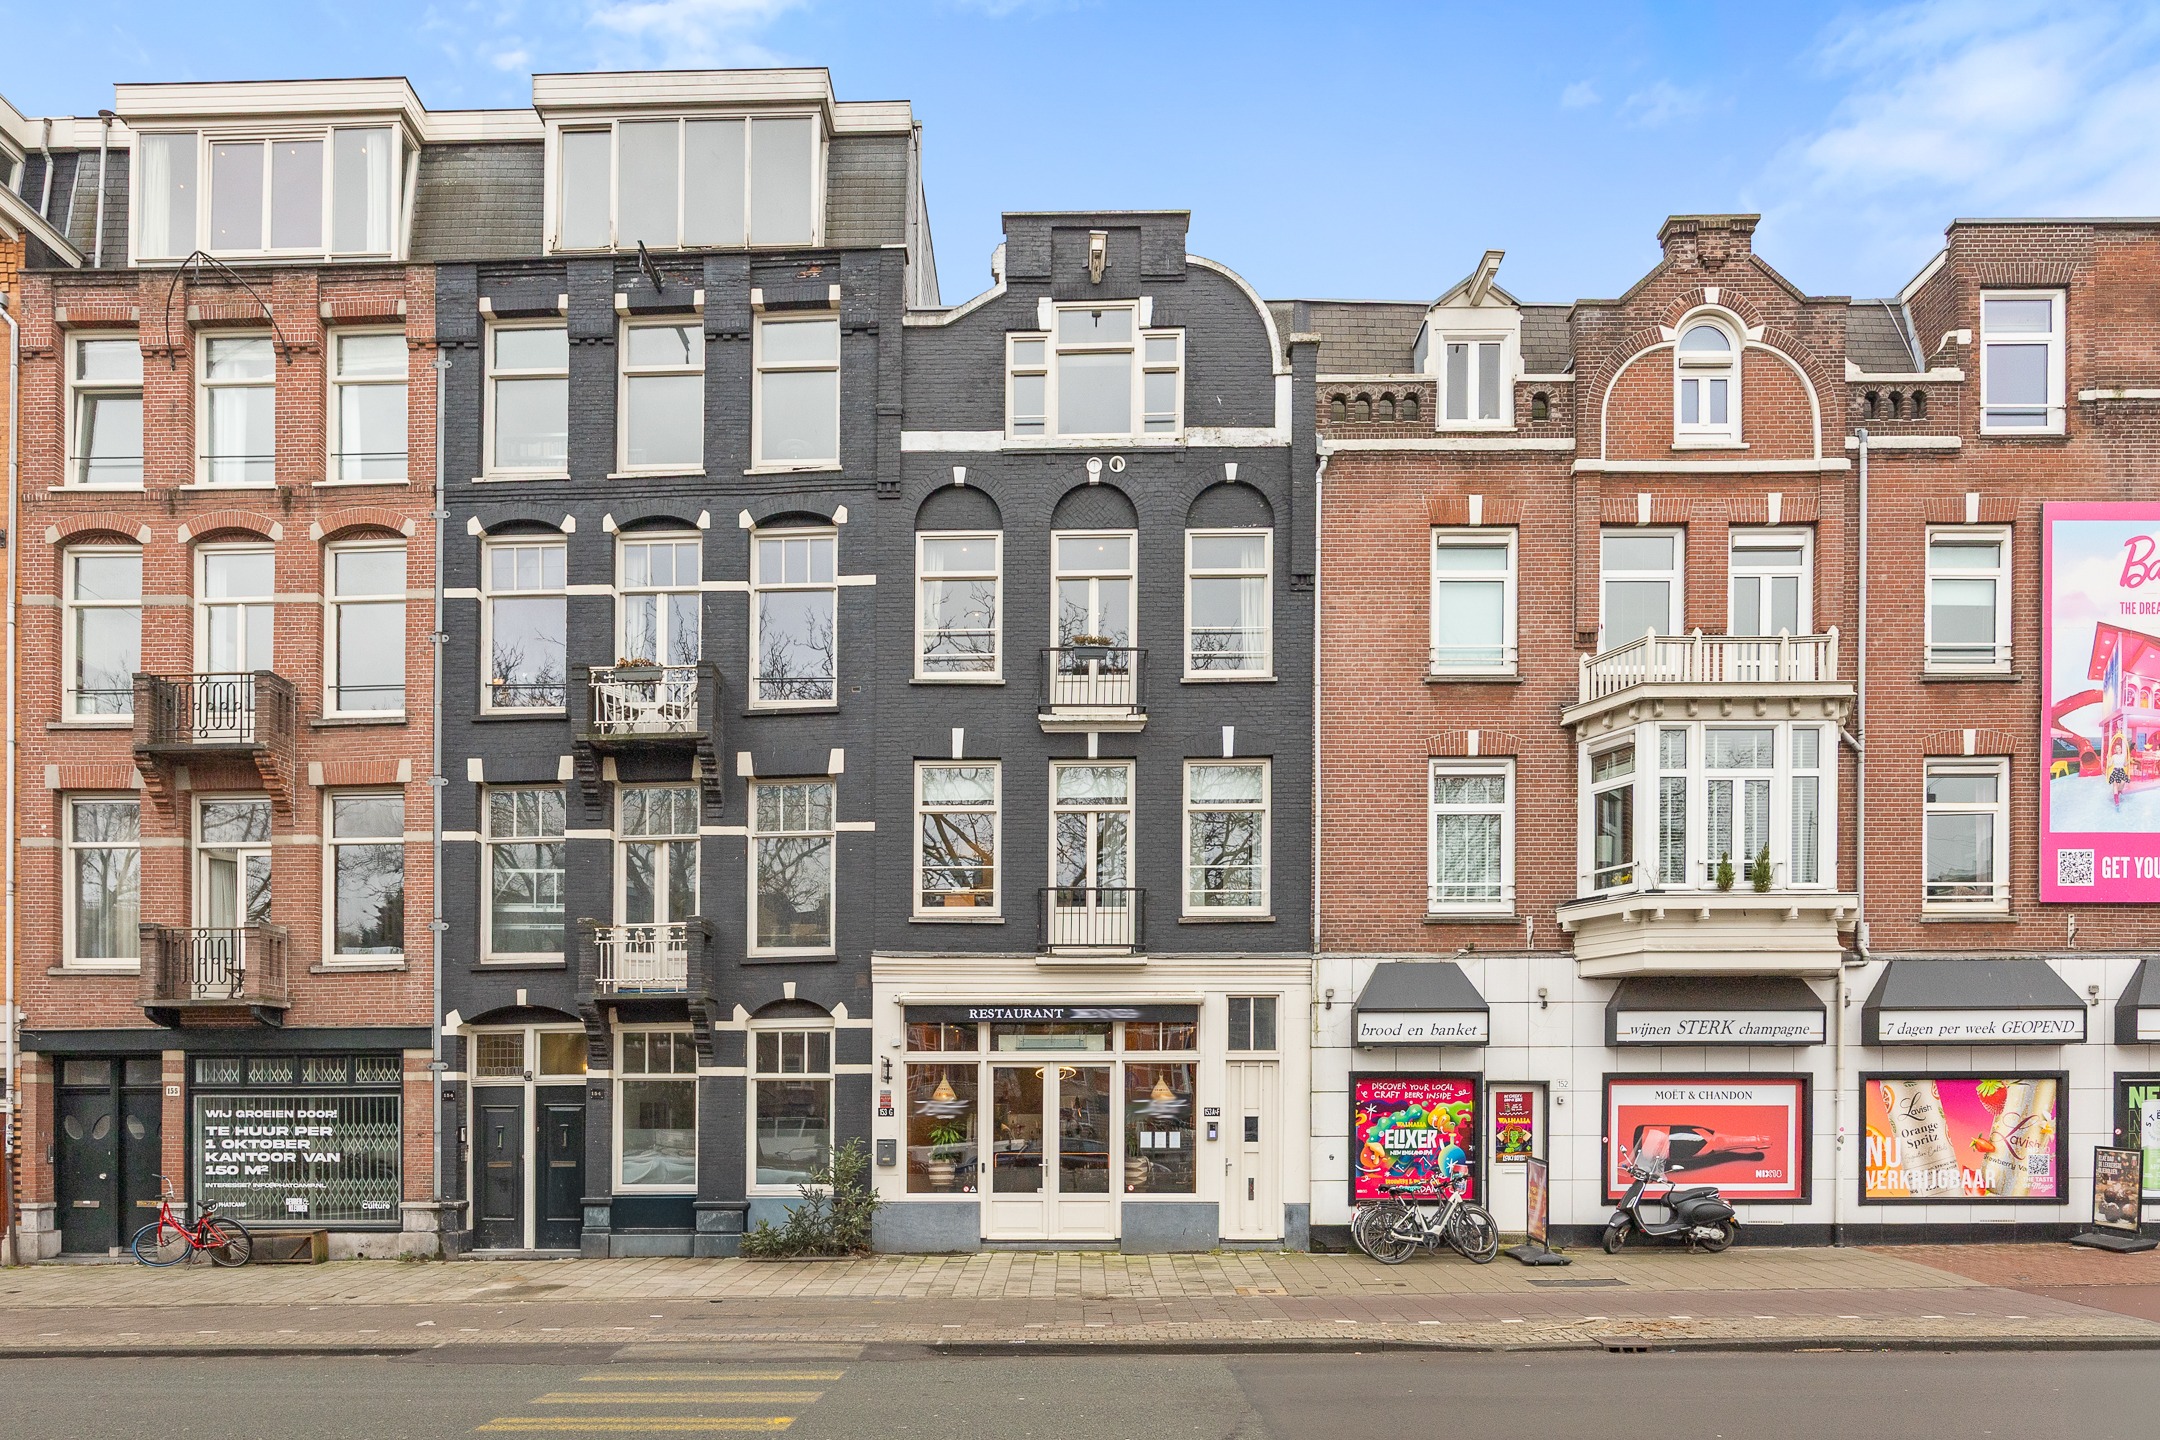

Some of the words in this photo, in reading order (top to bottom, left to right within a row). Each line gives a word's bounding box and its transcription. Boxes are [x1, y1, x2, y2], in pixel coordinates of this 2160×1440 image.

[2120, 602, 2137, 615] THE
[2101, 856, 2131, 879] GET
[969, 1008, 1064, 1019] RESTAURANT
[1361, 1023, 1403, 1036] brood
[1407, 1026, 1424, 1036] en
[1430, 1023, 1477, 1036] banket
[1630, 1022, 1671, 1038] wijnen
[1676, 1019, 1736, 1035] STERK
[1738, 1022, 1810, 1038] champagne
[1887, 1023, 1895, 1035] 7
[1897, 1022, 1933, 1037] dagen
[1938, 1026, 1961, 1037] per
[1966, 1022, 1996, 1034] week
[2001, 1020, 2075, 1034] GEOPEND
[1372, 1082, 1407, 1091] DISCOVER
[1410, 1083, 1430, 1092] YOUR
[1432, 1083, 1455, 1092] LOCAL
[1558, 1080, 1568, 1088] 152
[167, 1087, 179, 1095] 155
[1374, 1091, 1400, 1099] CRAFT
[1426, 1092, 1452, 1100] INSIDE
[1654, 1089, 1685, 1100] MOËT
[1688, 1090, 1696, 1100] &
[1698, 1090, 1753, 1100] CHANDON
[879, 1108, 888, 1116] 153
[1898, 1092, 1933, 1121] Lavish
[205, 1110, 232, 1118] WIJ
[235, 1110, 294, 1118] GROEIEN
[297, 1110, 337, 1118] DOOR!
[205, 1126, 230, 1136] TE
[235, 1126, 289, 1136] HUUR
[294, 1126, 333, 1136] PER
[1901, 1122, 1939, 1138] Orange
[205, 1140, 216, 1149] 1
[221, 1140, 311, 1149] OKTOBER
[1385, 1129, 1438, 1149] ELIXER
[1906, 1133, 1939, 1149] Spritz
[205, 1152, 297, 1162] KANTOOR
[301, 1152, 340, 1162] VAN
[1866, 1136, 1901, 1167] NU
[205, 1165, 239, 1175] 150
[1866, 1169, 1996, 1190] VERKRIJGBAAR
